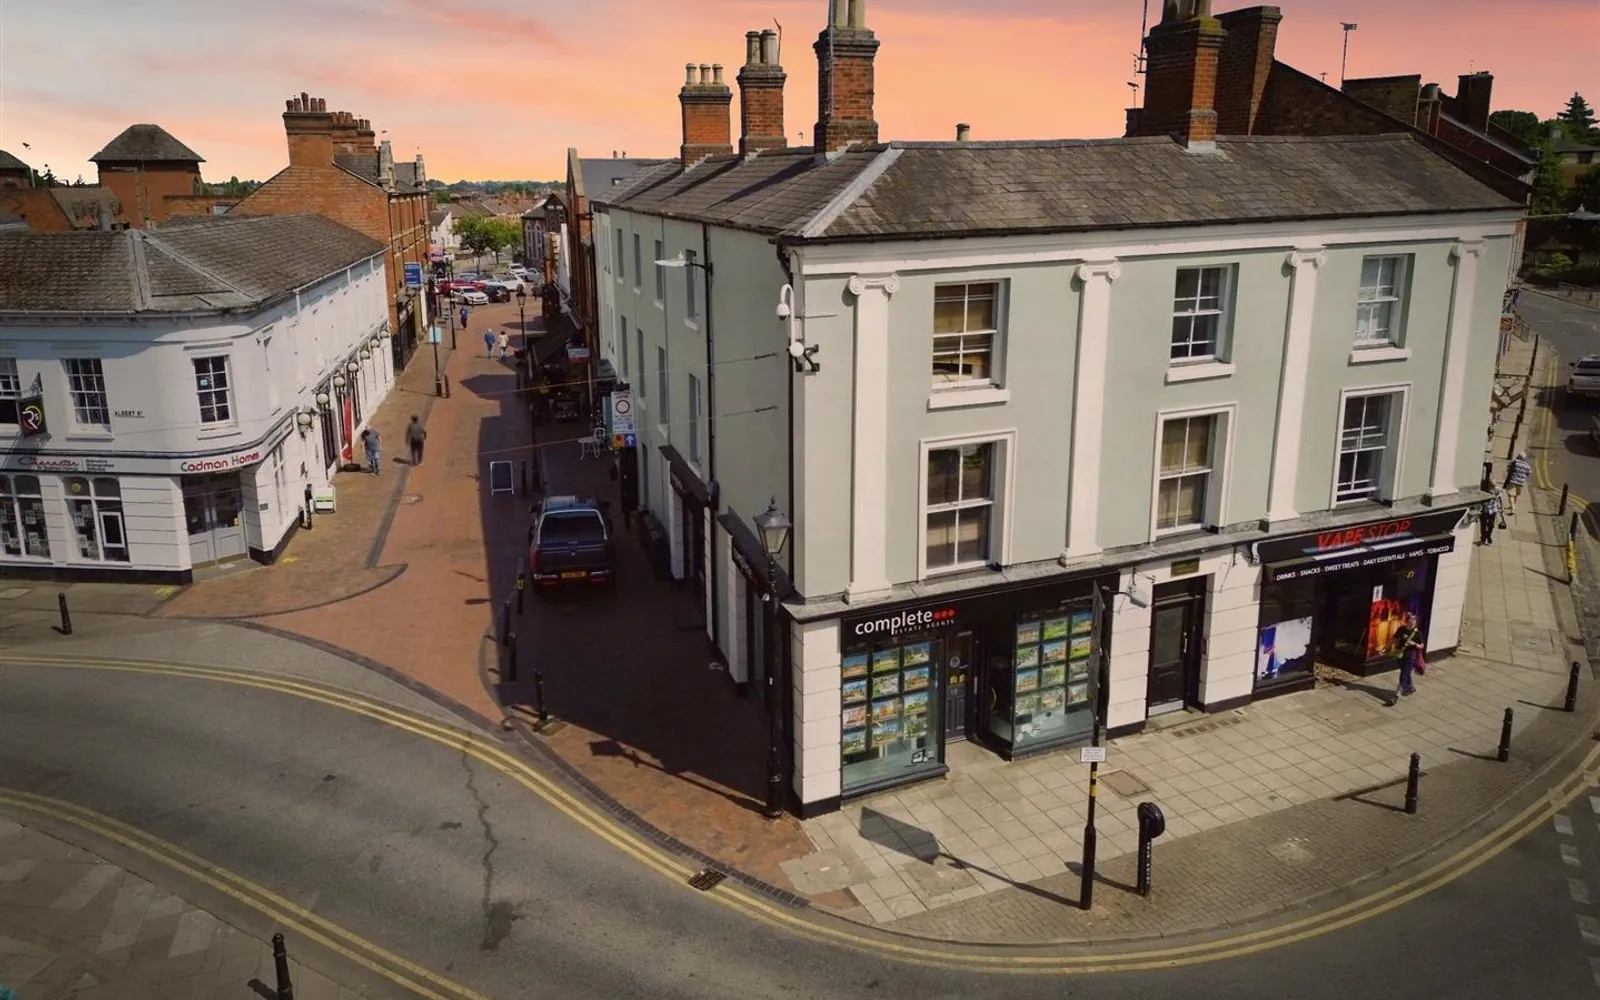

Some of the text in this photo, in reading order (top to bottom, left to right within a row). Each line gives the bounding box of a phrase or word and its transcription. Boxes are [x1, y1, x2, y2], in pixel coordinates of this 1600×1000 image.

[231, 451, 260, 466] Homes
[1317, 519, 1412, 551] VAPE STOP
[1276, 544, 1450, 581] DRINKS SNACKS SWEET TREATS DAILY ESSENTIALS VAPES TOBACCO
[854, 609, 933, 636] complete
[894, 618, 955, 635] ESTATE AGENTS
